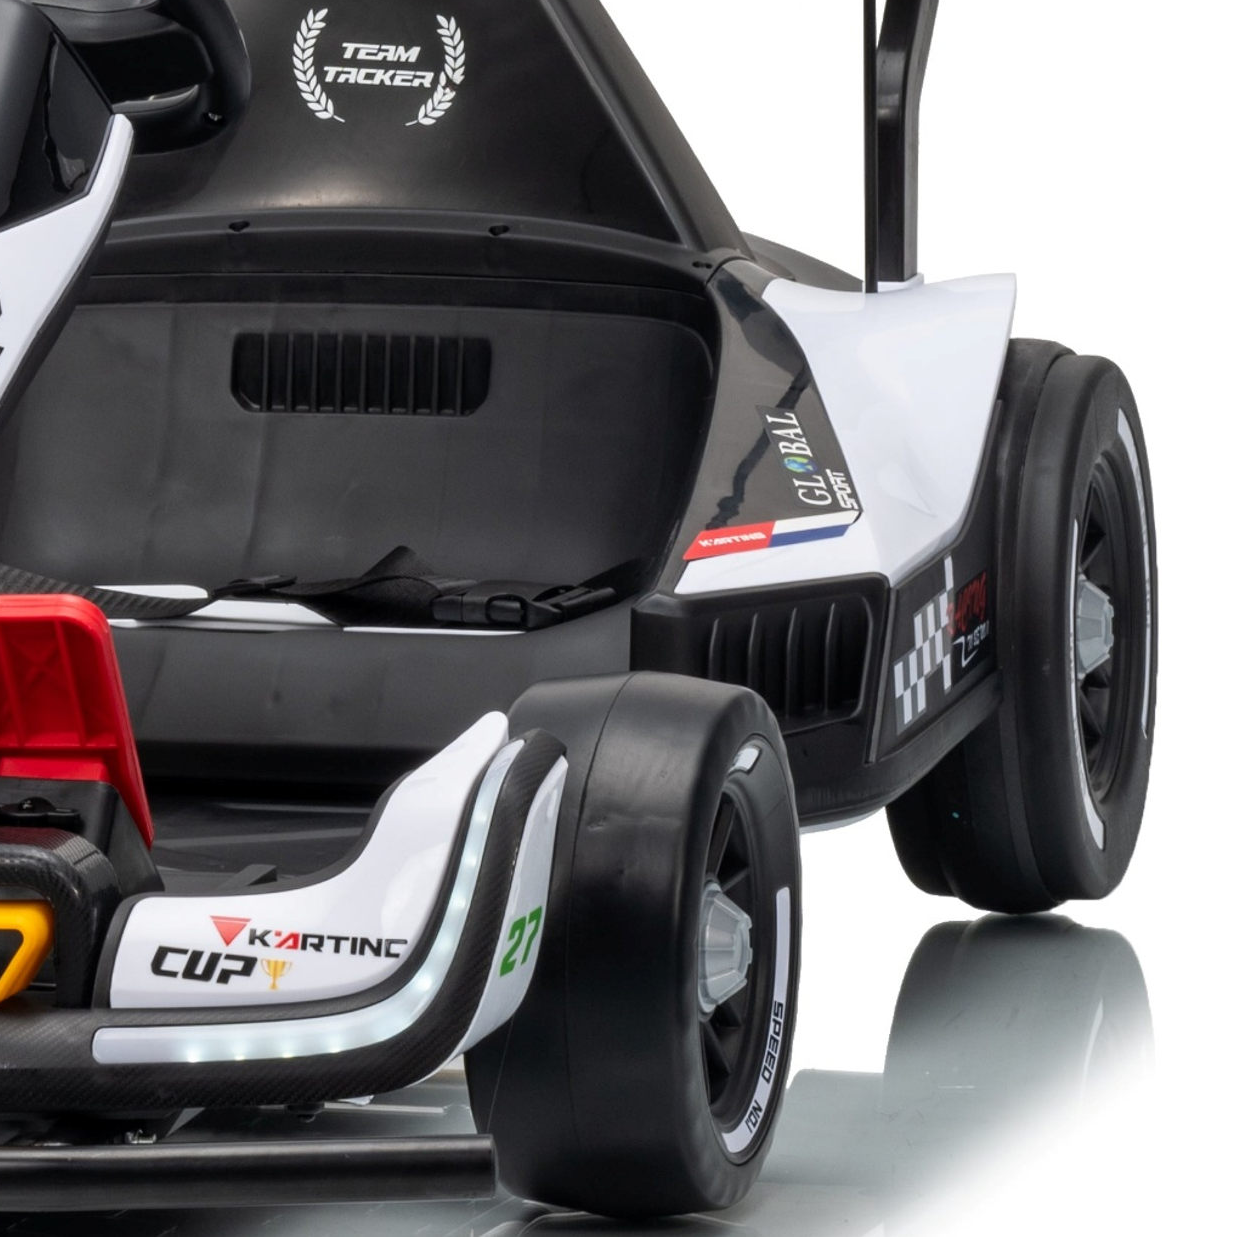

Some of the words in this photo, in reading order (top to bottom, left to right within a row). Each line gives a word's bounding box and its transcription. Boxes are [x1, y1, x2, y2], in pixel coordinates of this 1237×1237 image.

[341, 42, 421, 62] TEAM
[323, 66, 434, 88] TACKER
[825, 468, 859, 510] SPORT
[499, 906, 543, 977] 27
[150, 945, 258, 985] CUP
[761, 1000, 784, 1085] SPEED
